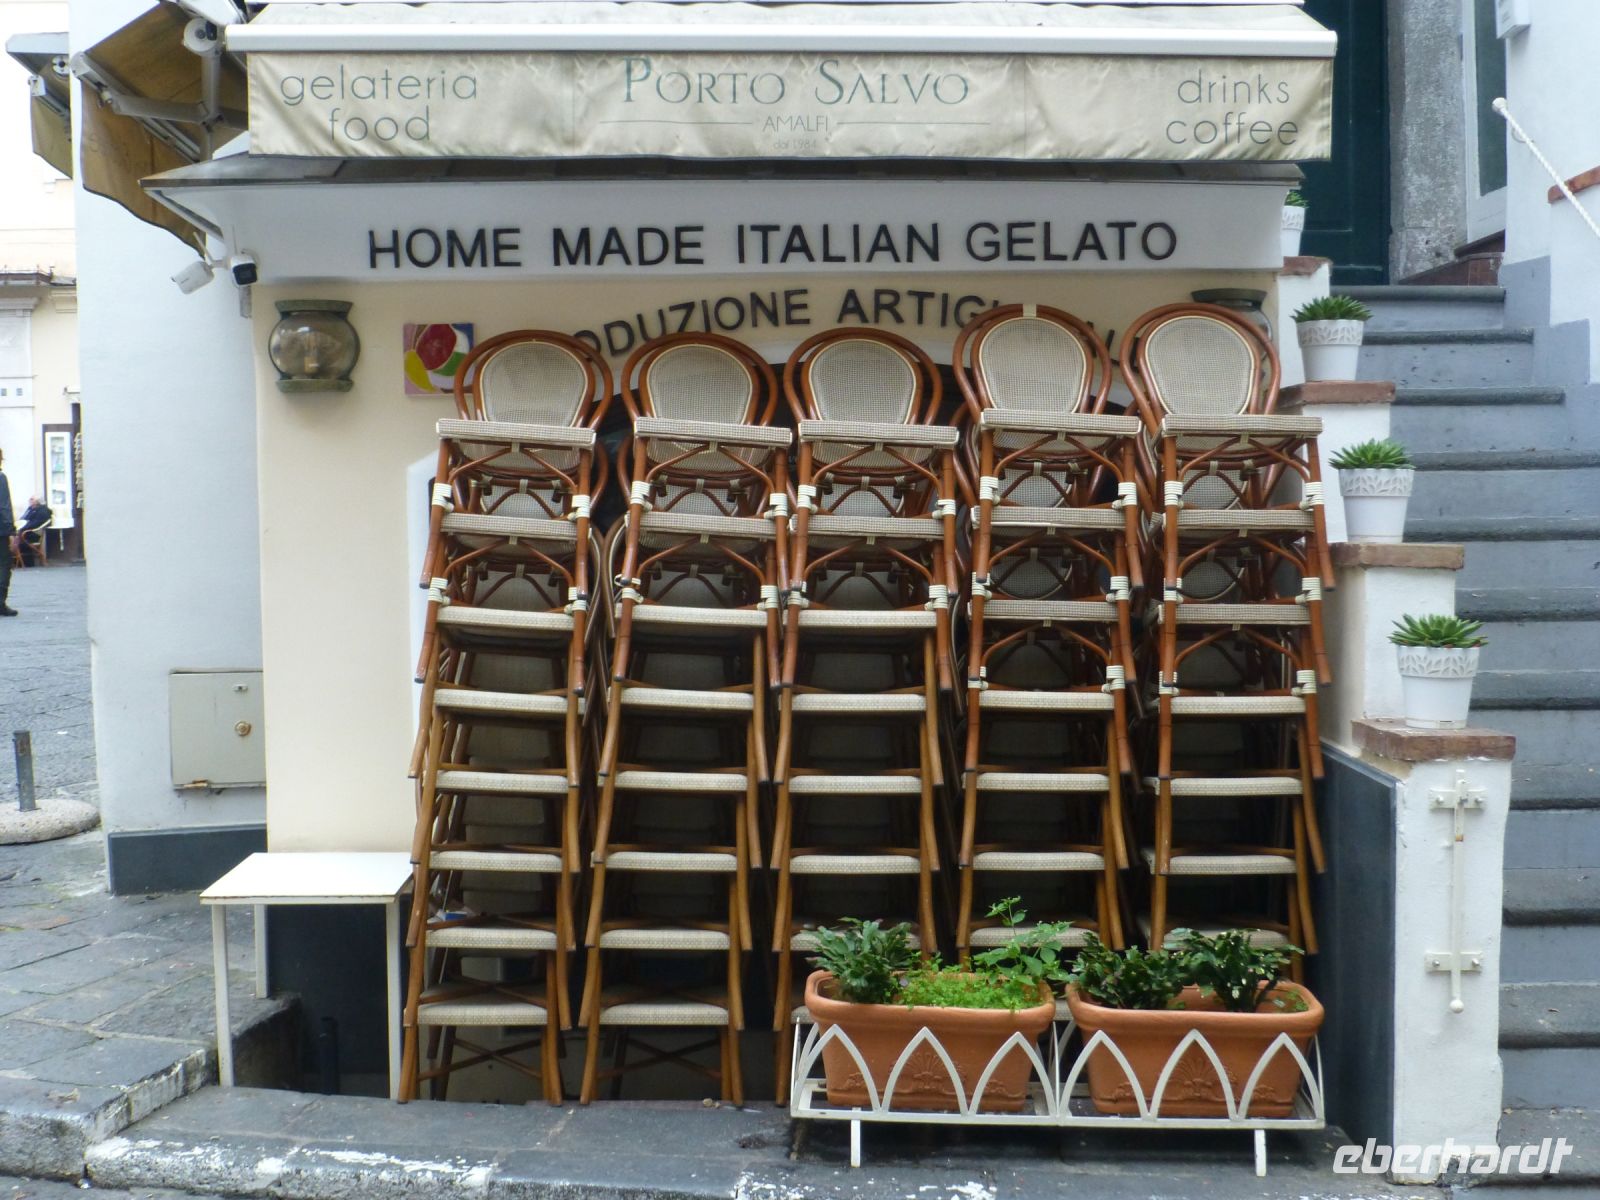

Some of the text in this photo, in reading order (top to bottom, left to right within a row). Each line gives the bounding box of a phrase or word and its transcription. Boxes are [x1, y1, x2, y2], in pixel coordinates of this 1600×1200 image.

[280, 64, 478, 106] gelateria
[622, 56, 969, 105] PORTO SALVO
[1177, 68, 1290, 104] drinks
[329, 106, 431, 142] food
[762, 115, 828, 132] AMALFI
[1166, 111, 1298, 146] coffee
[368, 221, 1178, 269] HOME MADE ITALIAN GELATO
